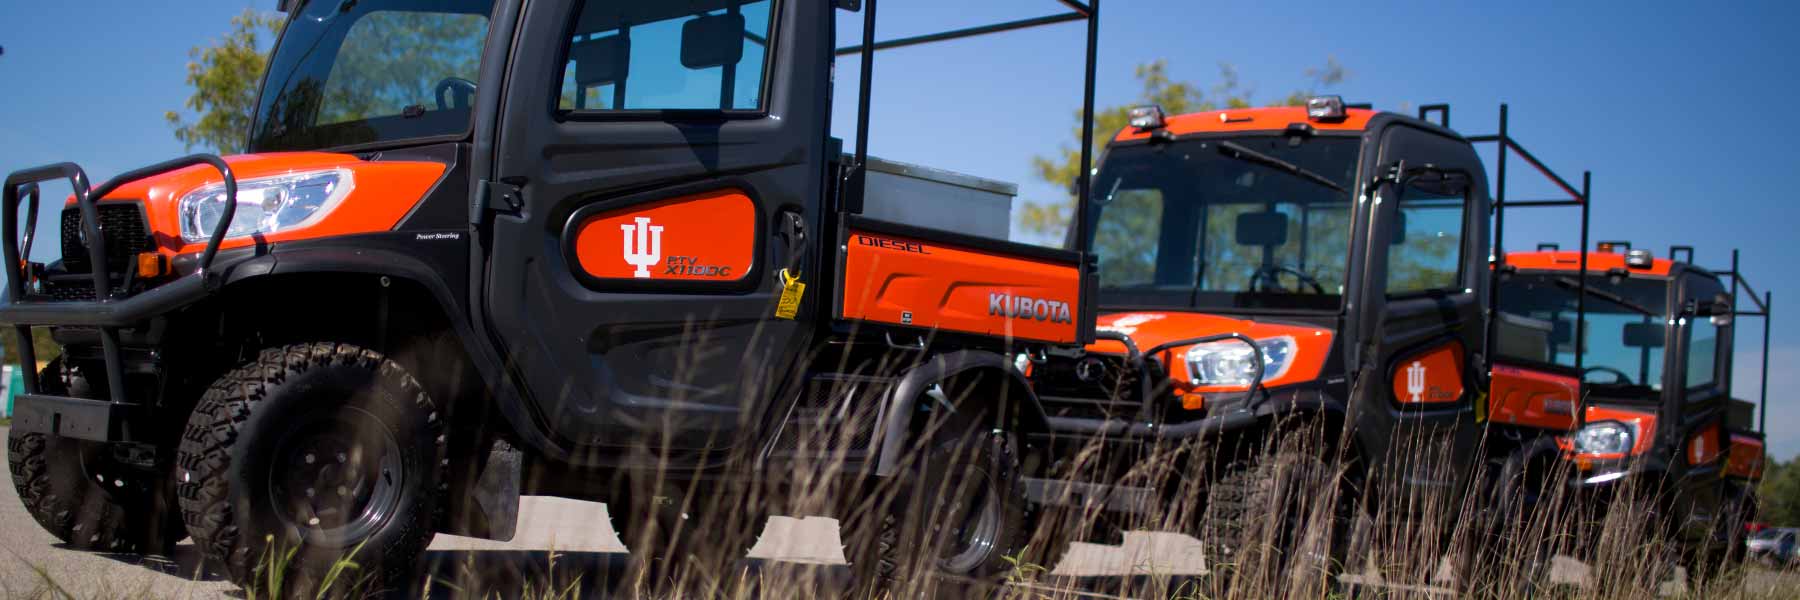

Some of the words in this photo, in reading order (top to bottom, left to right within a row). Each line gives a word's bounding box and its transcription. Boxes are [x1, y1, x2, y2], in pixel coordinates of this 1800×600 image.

[435, 232, 460, 240] Steering
[857, 235, 931, 255] DIESEL
[667, 256, 698, 265] RTV
[989, 292, 1072, 323] KUBOTA
